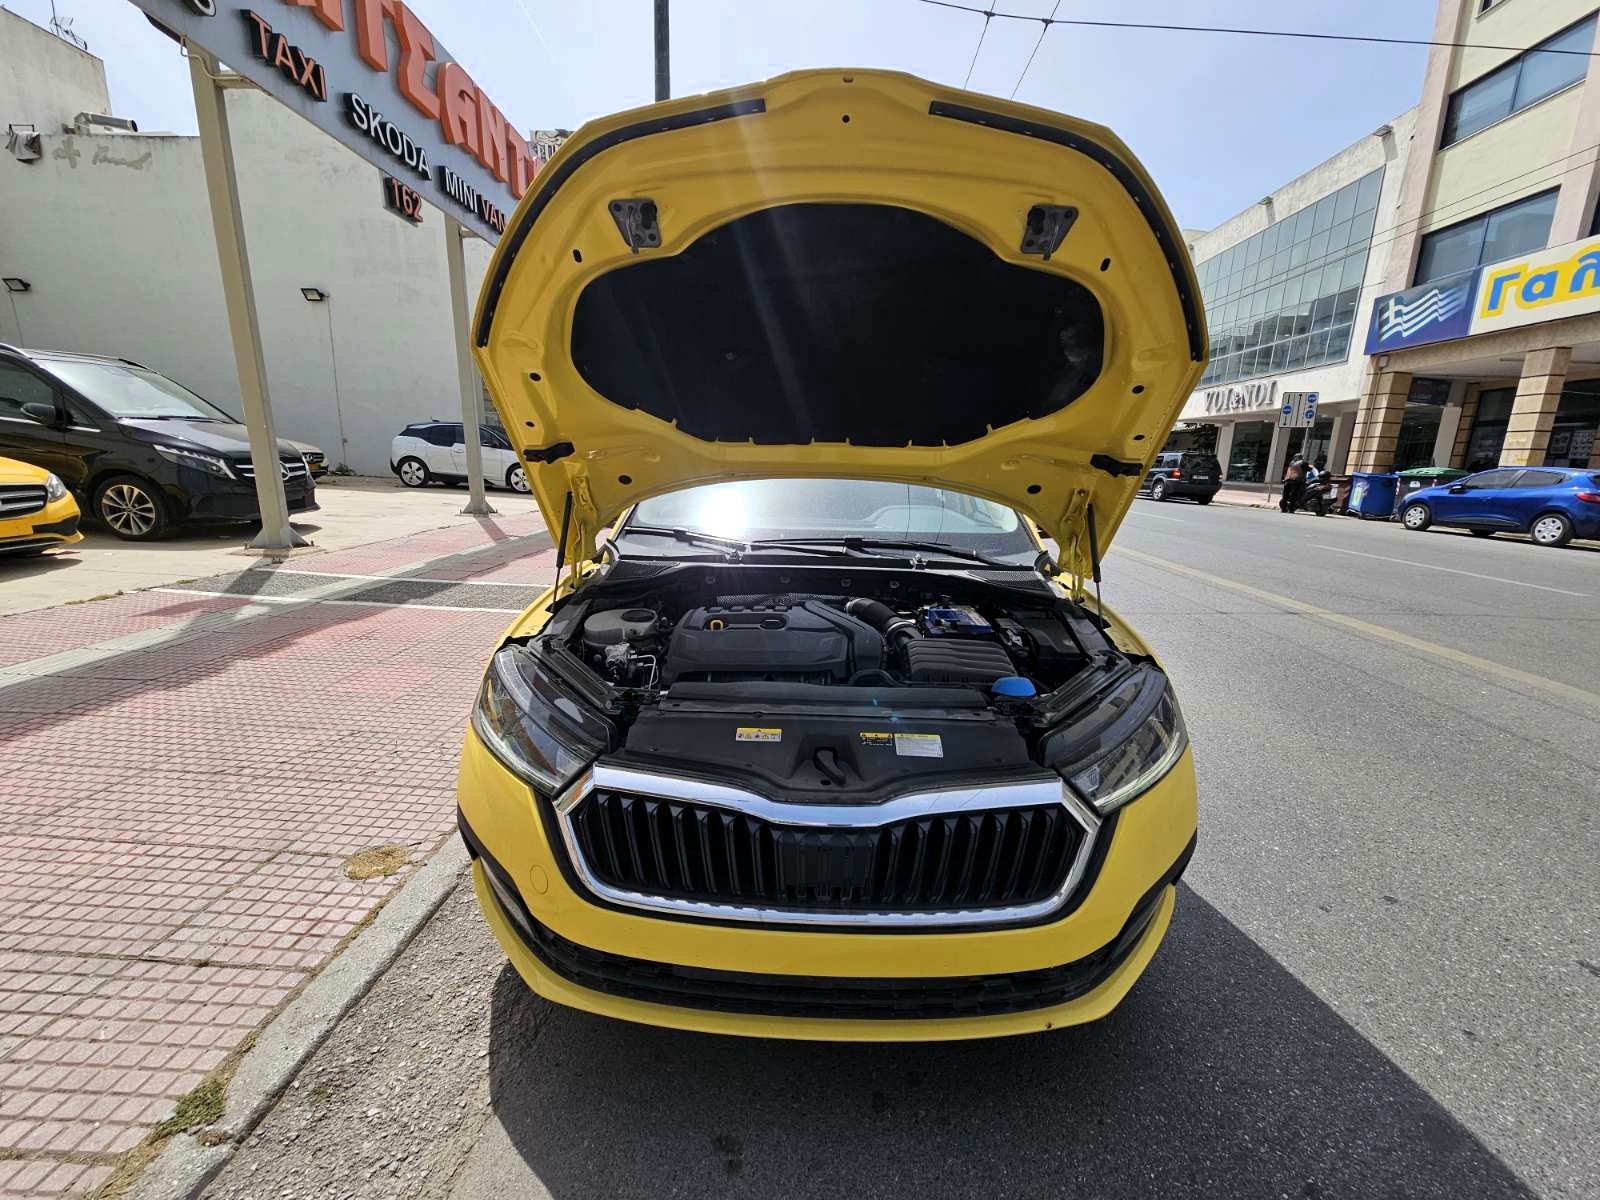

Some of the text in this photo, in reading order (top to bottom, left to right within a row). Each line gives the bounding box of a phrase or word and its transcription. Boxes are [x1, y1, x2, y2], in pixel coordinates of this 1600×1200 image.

[247, 10, 327, 102] TAXI
[350, 92, 432, 182] SKODA
[444, 167, 478, 213] MINI
[390, 177, 424, 222] 162
